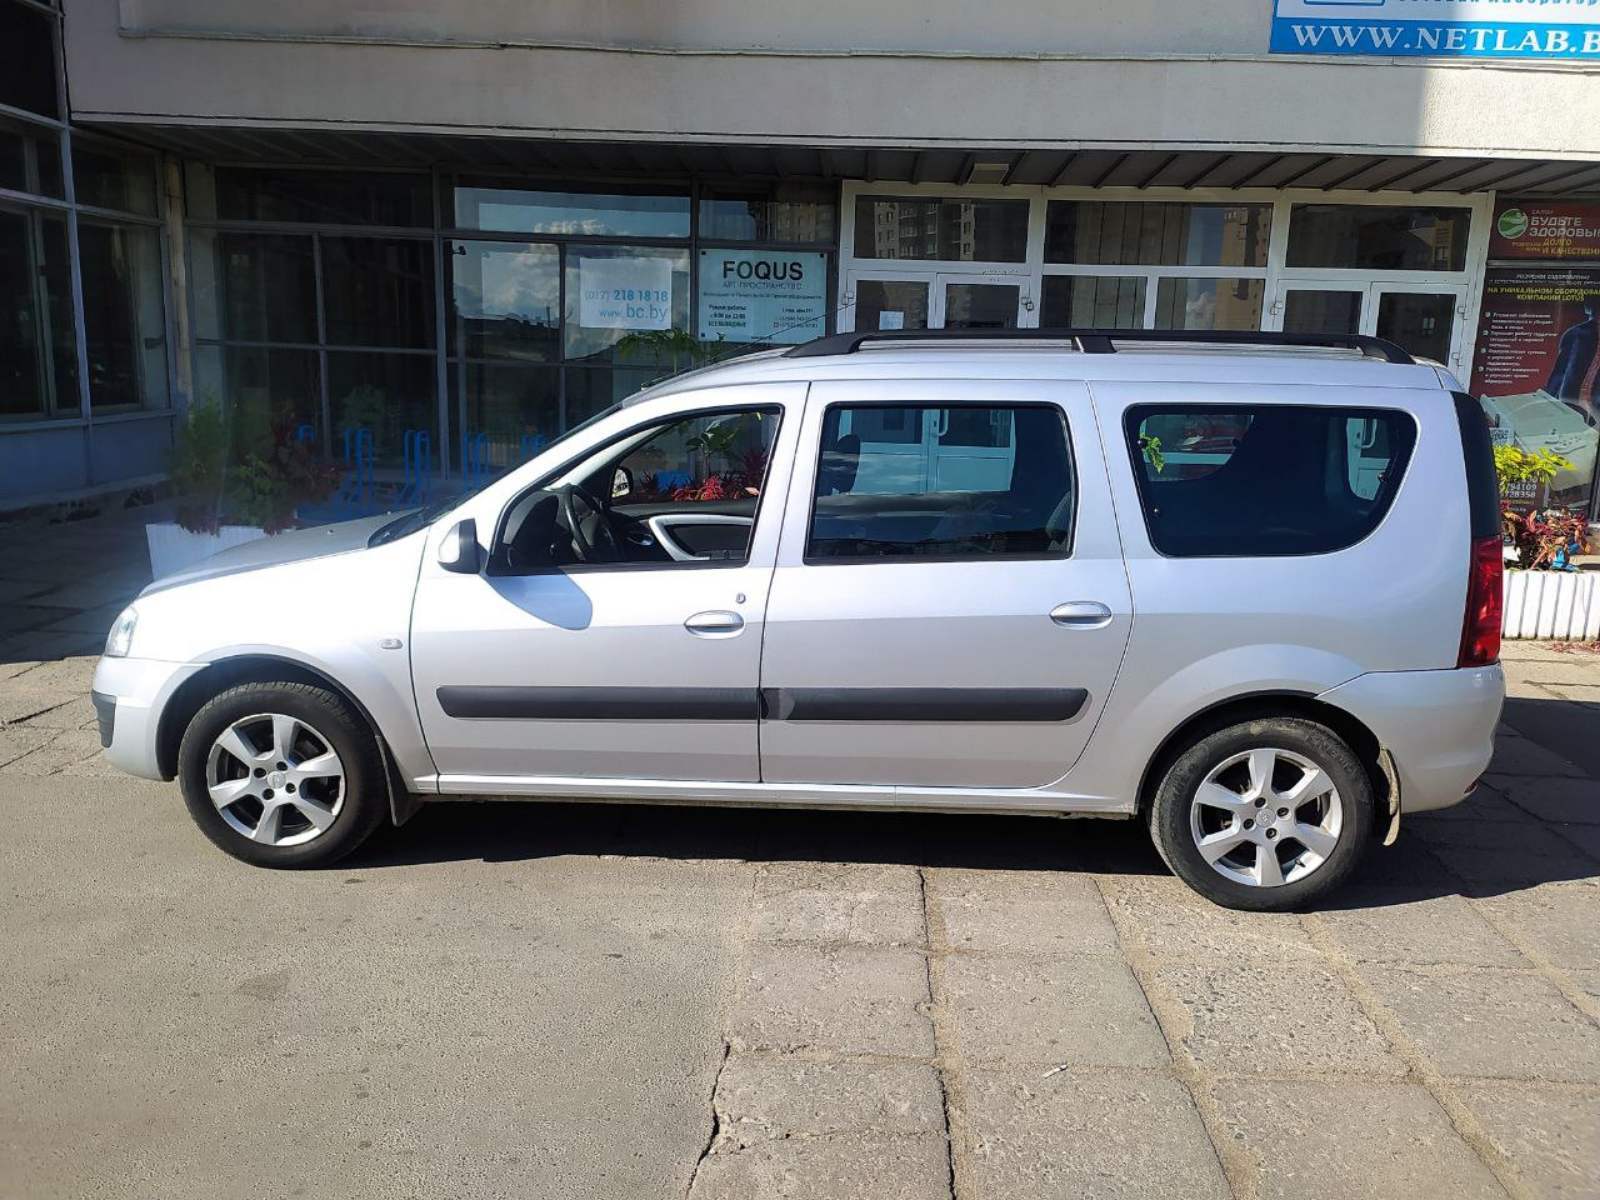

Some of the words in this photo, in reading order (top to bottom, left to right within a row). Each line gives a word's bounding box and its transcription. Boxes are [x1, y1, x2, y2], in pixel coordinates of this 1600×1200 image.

[1530, 216, 1582, 226] БУДЬТЕ
[723, 260, 804, 281] FOQUS
[613, 289, 634, 301] 218
[639, 290, 651, 301] 18
[654, 290, 669, 302] 18
[626, 303, 669, 321] bc.by
